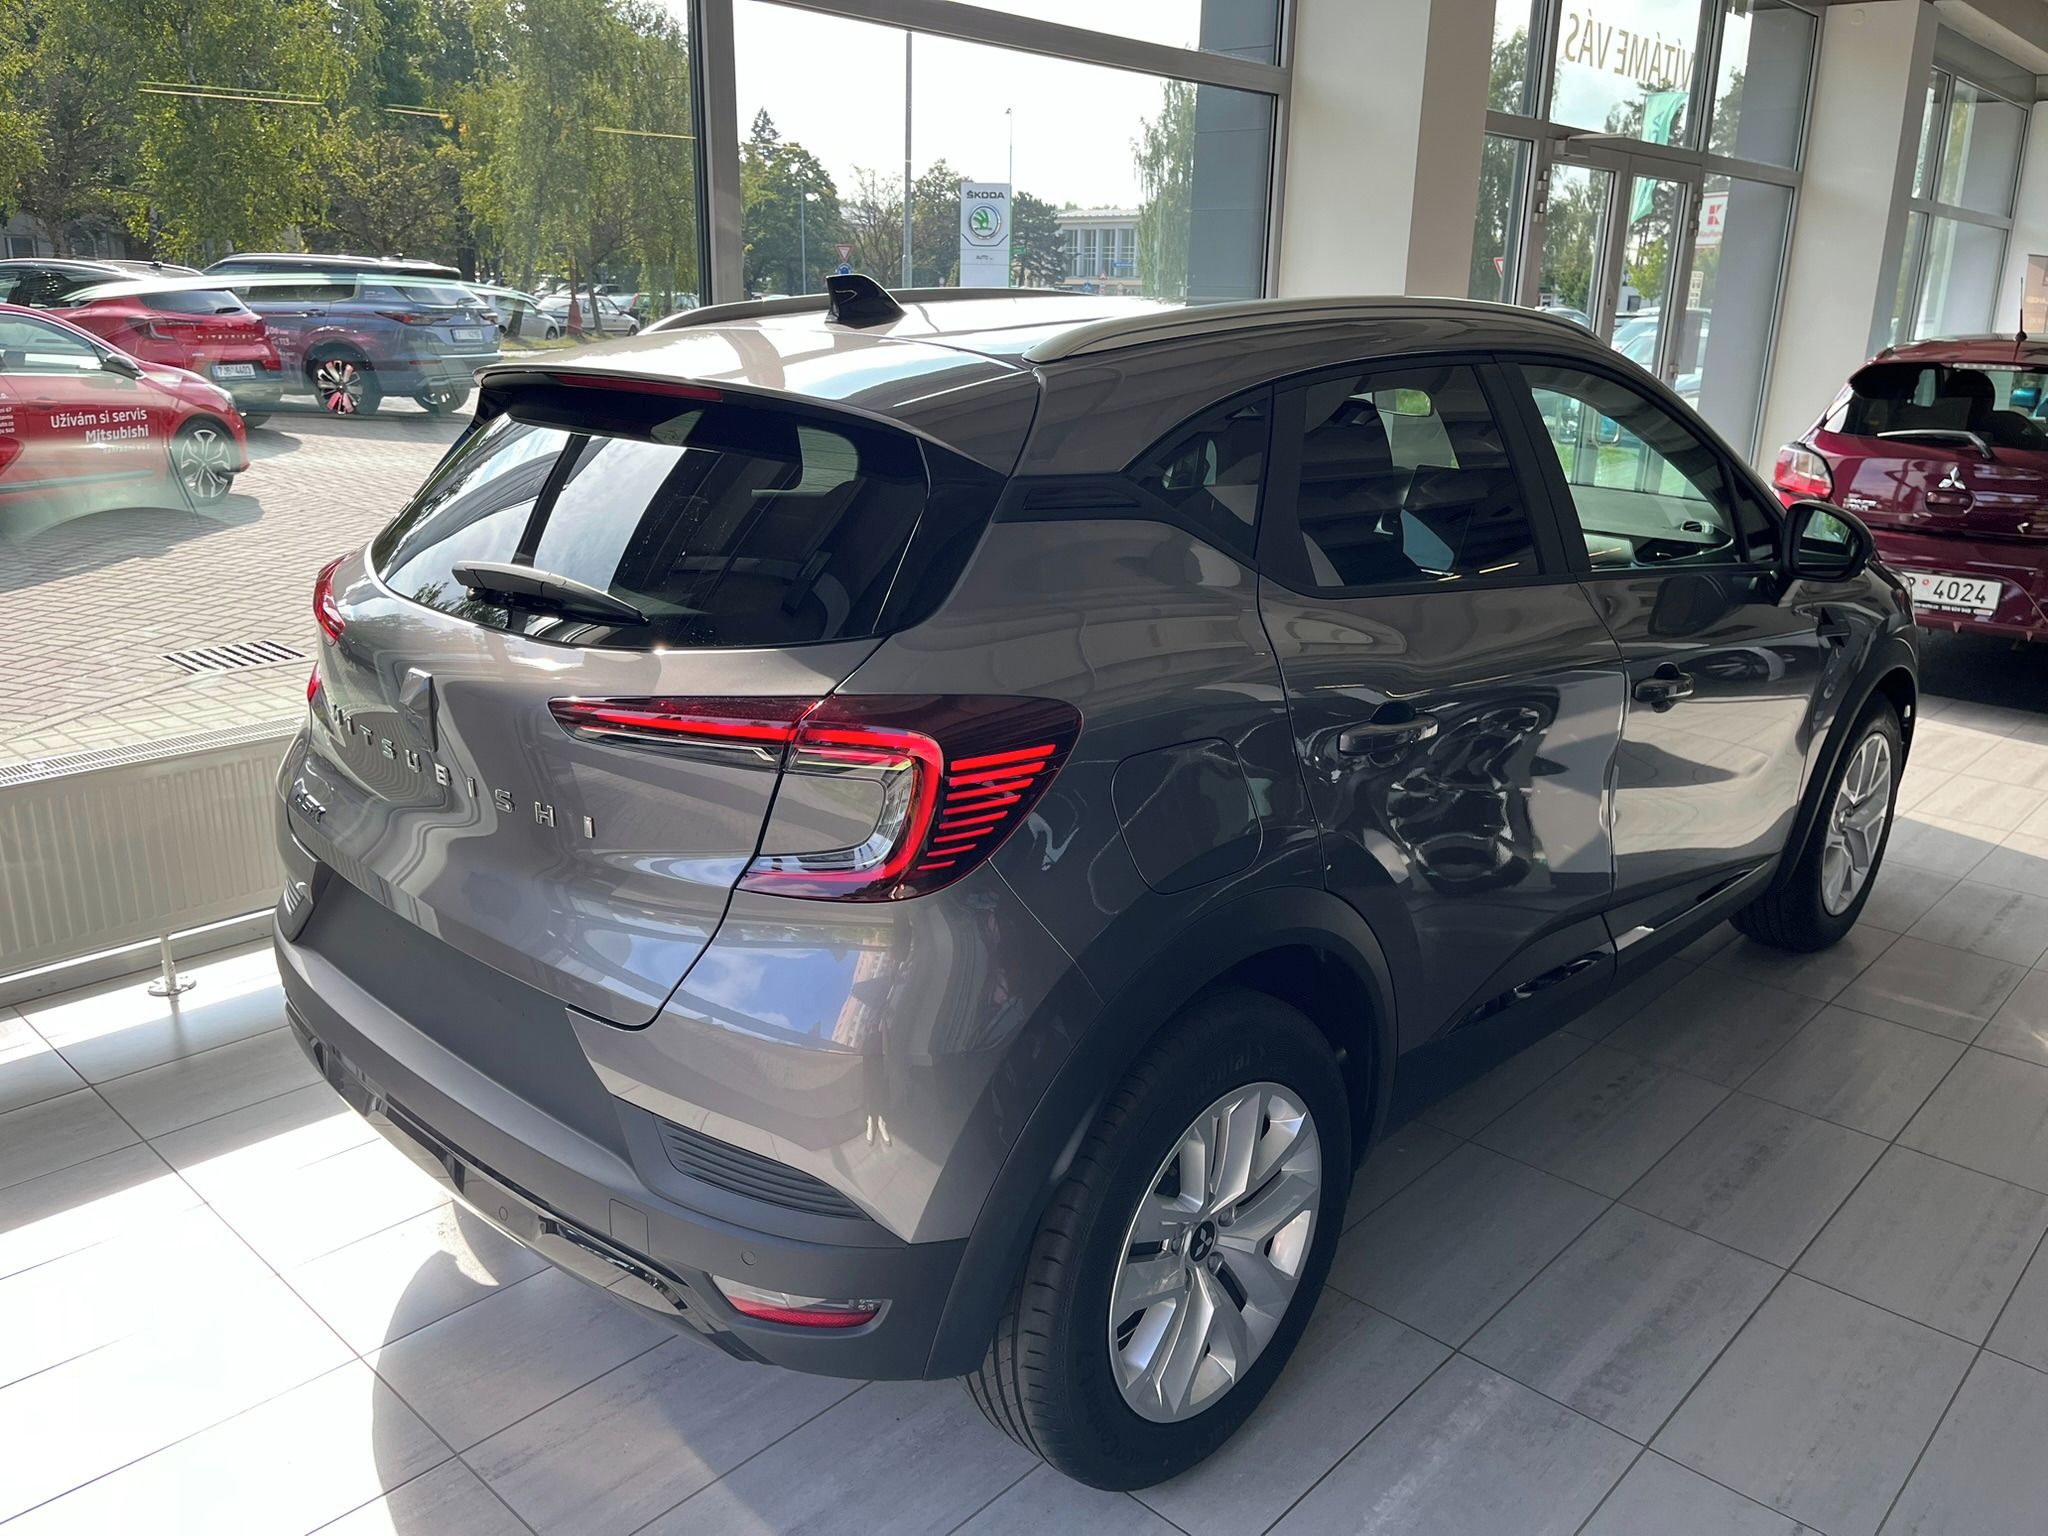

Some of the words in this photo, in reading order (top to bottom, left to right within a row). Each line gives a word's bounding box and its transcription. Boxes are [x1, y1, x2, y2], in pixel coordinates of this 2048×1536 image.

[966, 190, 1005, 199] ŠKODA
[50, 411, 97, 428] Užívám
[99, 410, 110, 424] si
[112, 407, 148, 422] servis
[85, 424, 149, 443] Mitsubishi
[1932, 579, 1987, 604] 4024
[333, 704, 596, 839] MITSUBISHI
